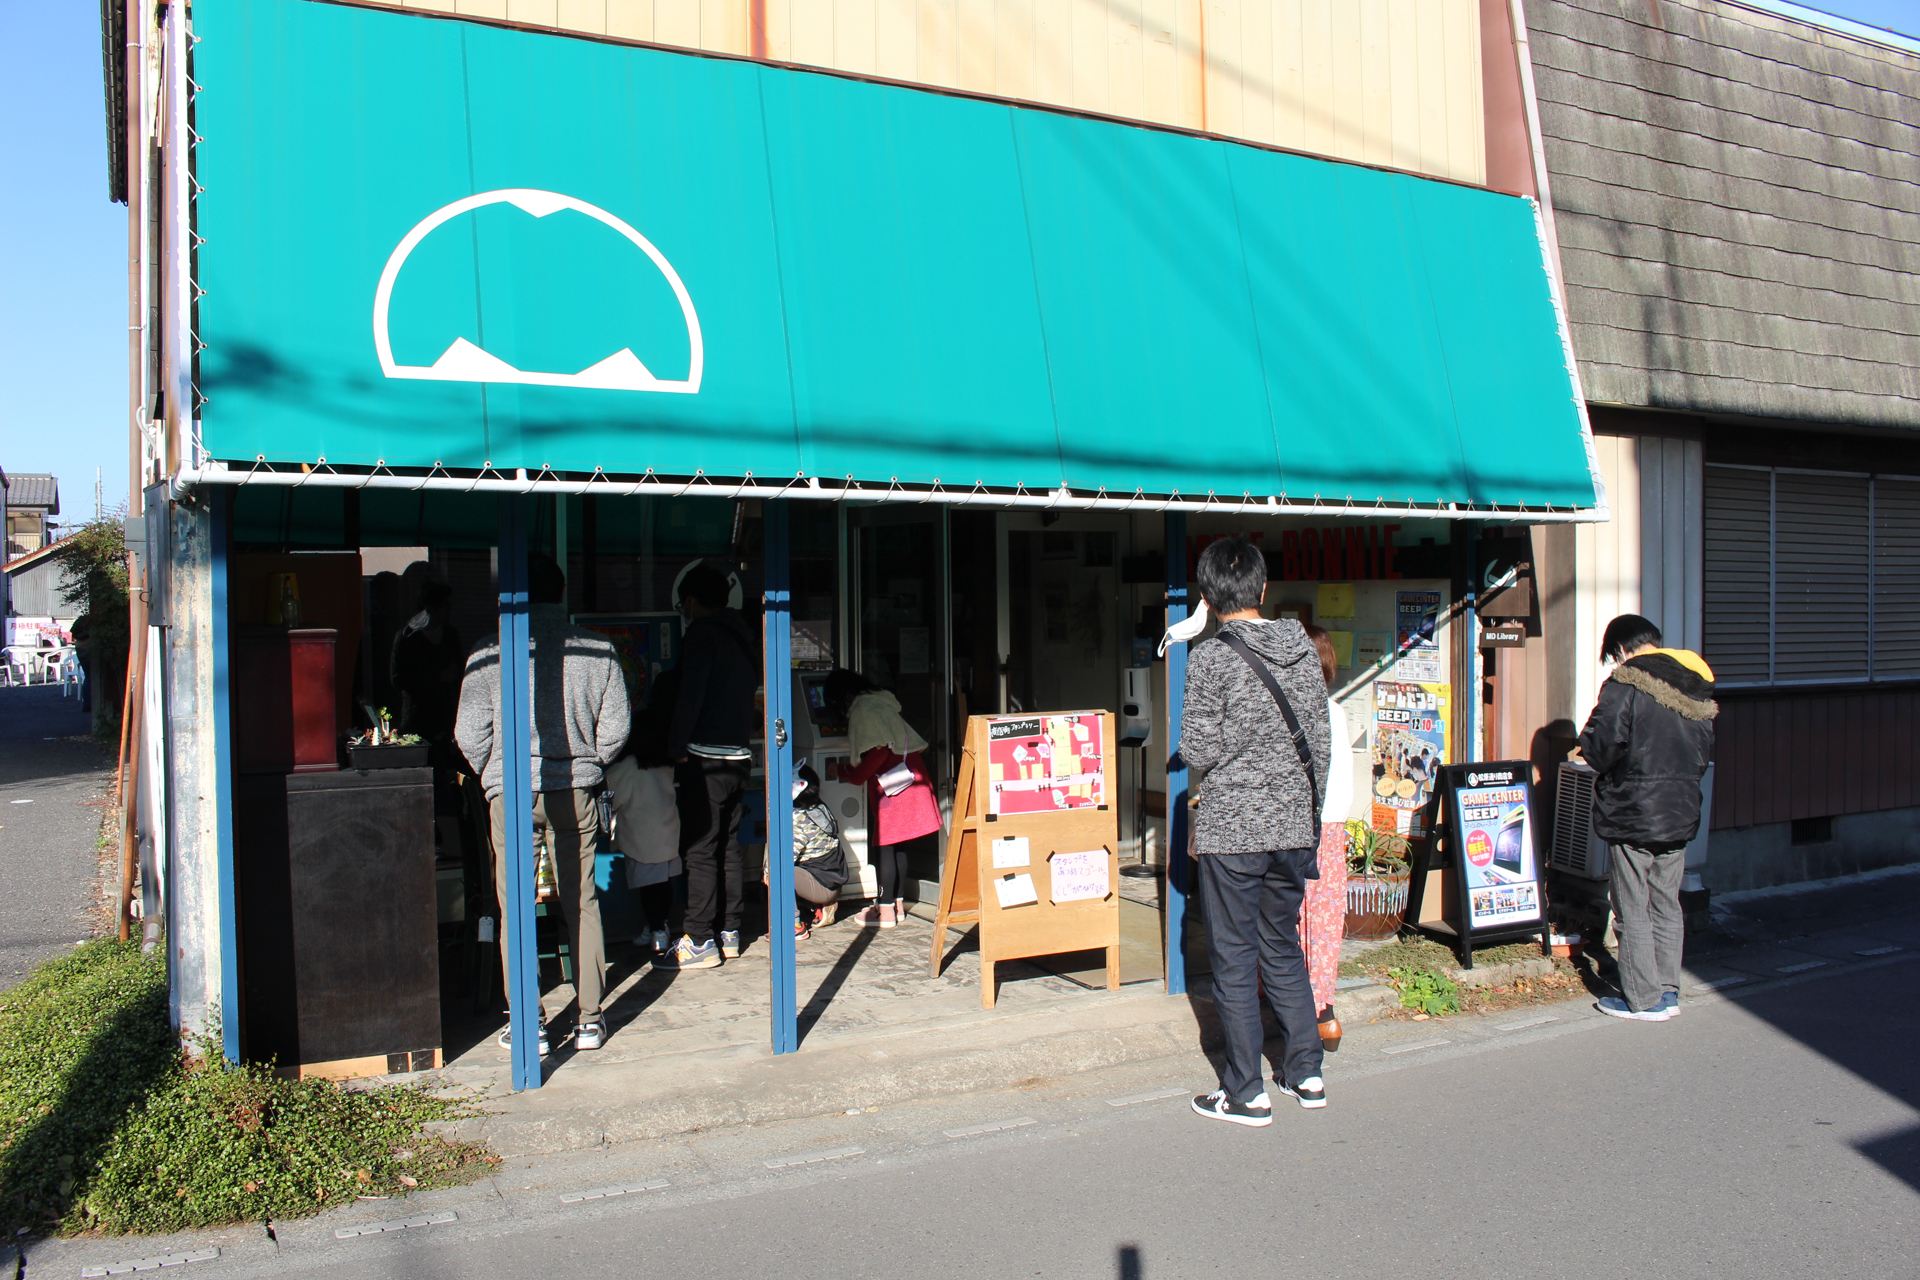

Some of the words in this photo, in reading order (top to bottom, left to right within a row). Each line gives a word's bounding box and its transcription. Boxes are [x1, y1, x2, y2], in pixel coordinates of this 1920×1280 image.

[1282, 524, 1401, 581] BONNIE
[1400, 604, 1422, 613] BEEP
[1485, 632, 1496, 640] MD
[1496, 632, 1519, 642] Library
[1376, 689, 1447, 711] ゲームセンター
[1378, 709, 1411, 722] BEEP
[1411, 718, 1420, 730] 12
[1461, 792, 1490, 806] GAME
[1490, 789, 1525, 804] CENTER
[1464, 806, 1499, 822] BEEP
